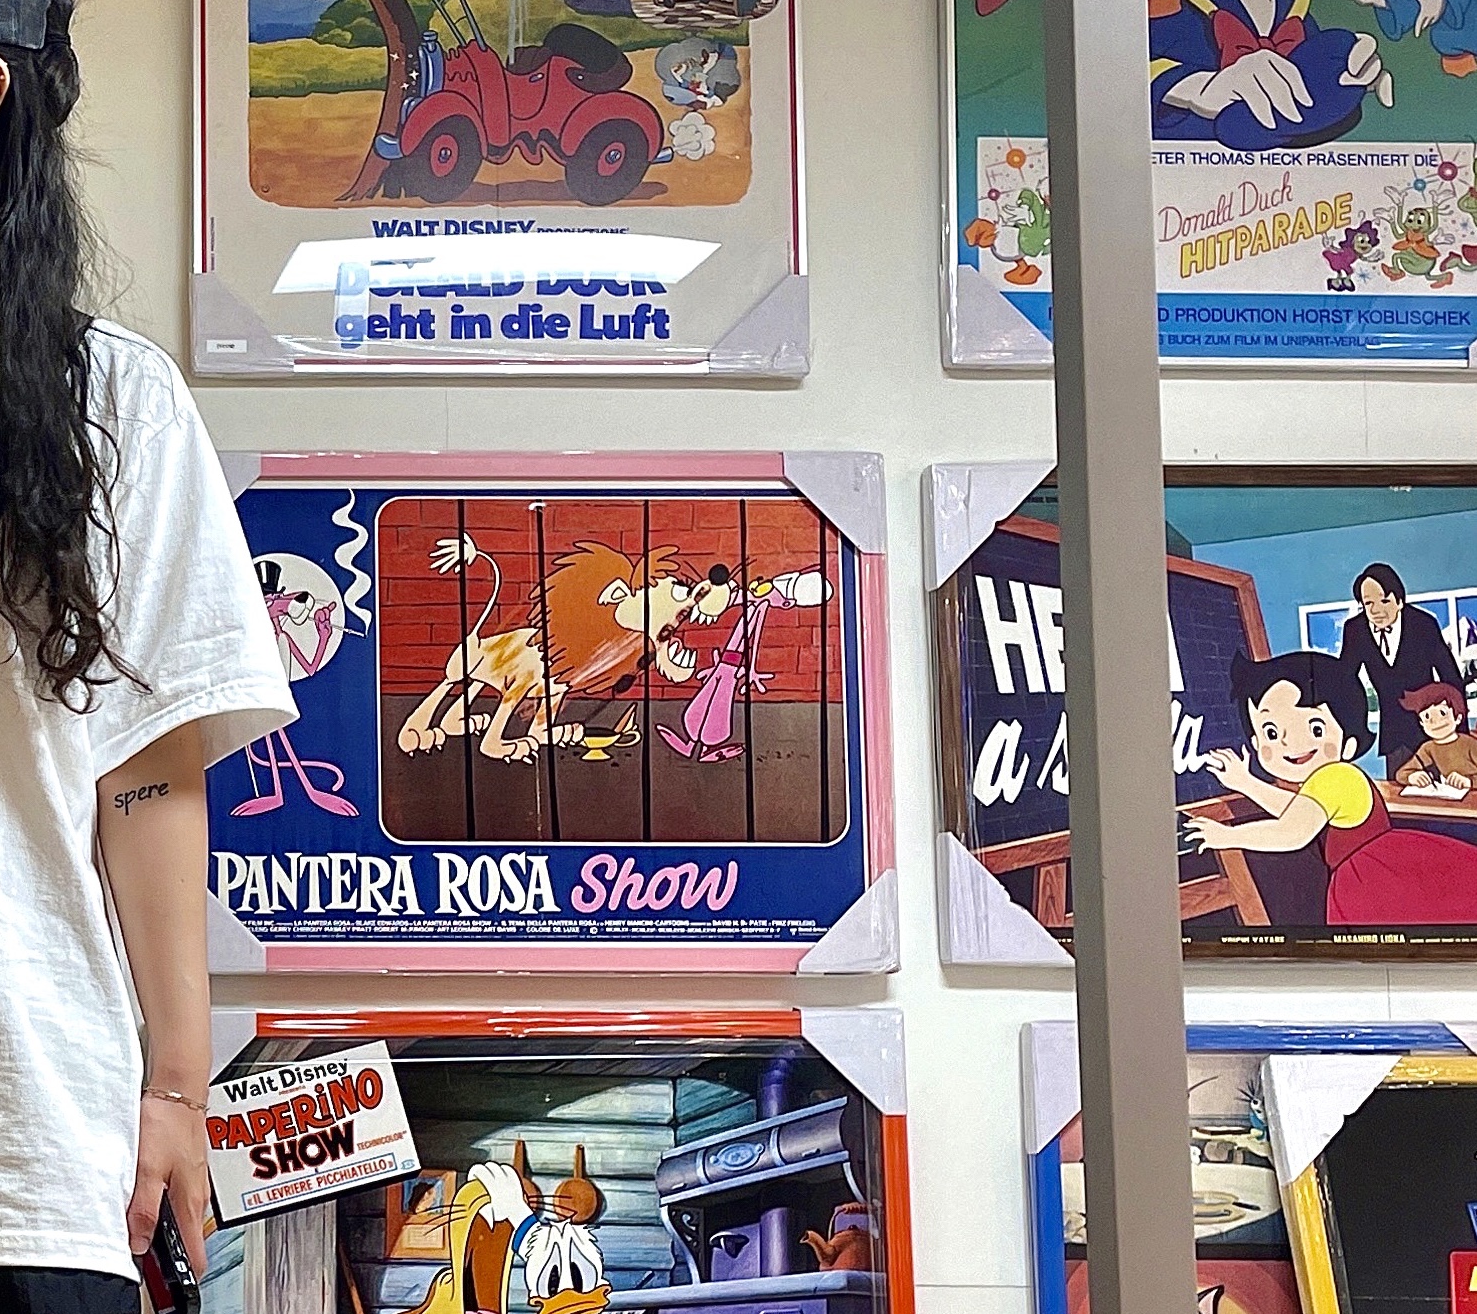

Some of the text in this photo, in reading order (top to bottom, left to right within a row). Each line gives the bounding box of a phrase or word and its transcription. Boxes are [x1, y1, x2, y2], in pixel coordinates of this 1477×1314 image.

[1151, 149, 1439, 167] ETER THOMAS HECK PRÄSENTIERT DIE
[1157, 170, 1294, 242] Donald Duck
[372, 219, 440, 237] WALT
[1179, 192, 1353, 279] HITPARADE
[334, 303, 671, 349] geht in die Luft
[1175, 307, 1287, 324] PRODUKTION
[1292, 308, 1354, 324] HORST
[1357, 309, 1471, 326] KOBLISCHEK
[1167, 334, 1202, 346] BUCH
[1204, 334, 1231, 346] ZUM
[1234, 334, 1261, 346] FILM
[1264, 335, 1278, 346] IM
[114, 782, 170, 816] spere
[211, 851, 739, 916] PANTERA ROSA Show
[222, 1059, 349, 1103] Walt Disney
[249, 1119, 356, 1180] SHOW
[265, 1180, 313, 1203] LEVRIERE
